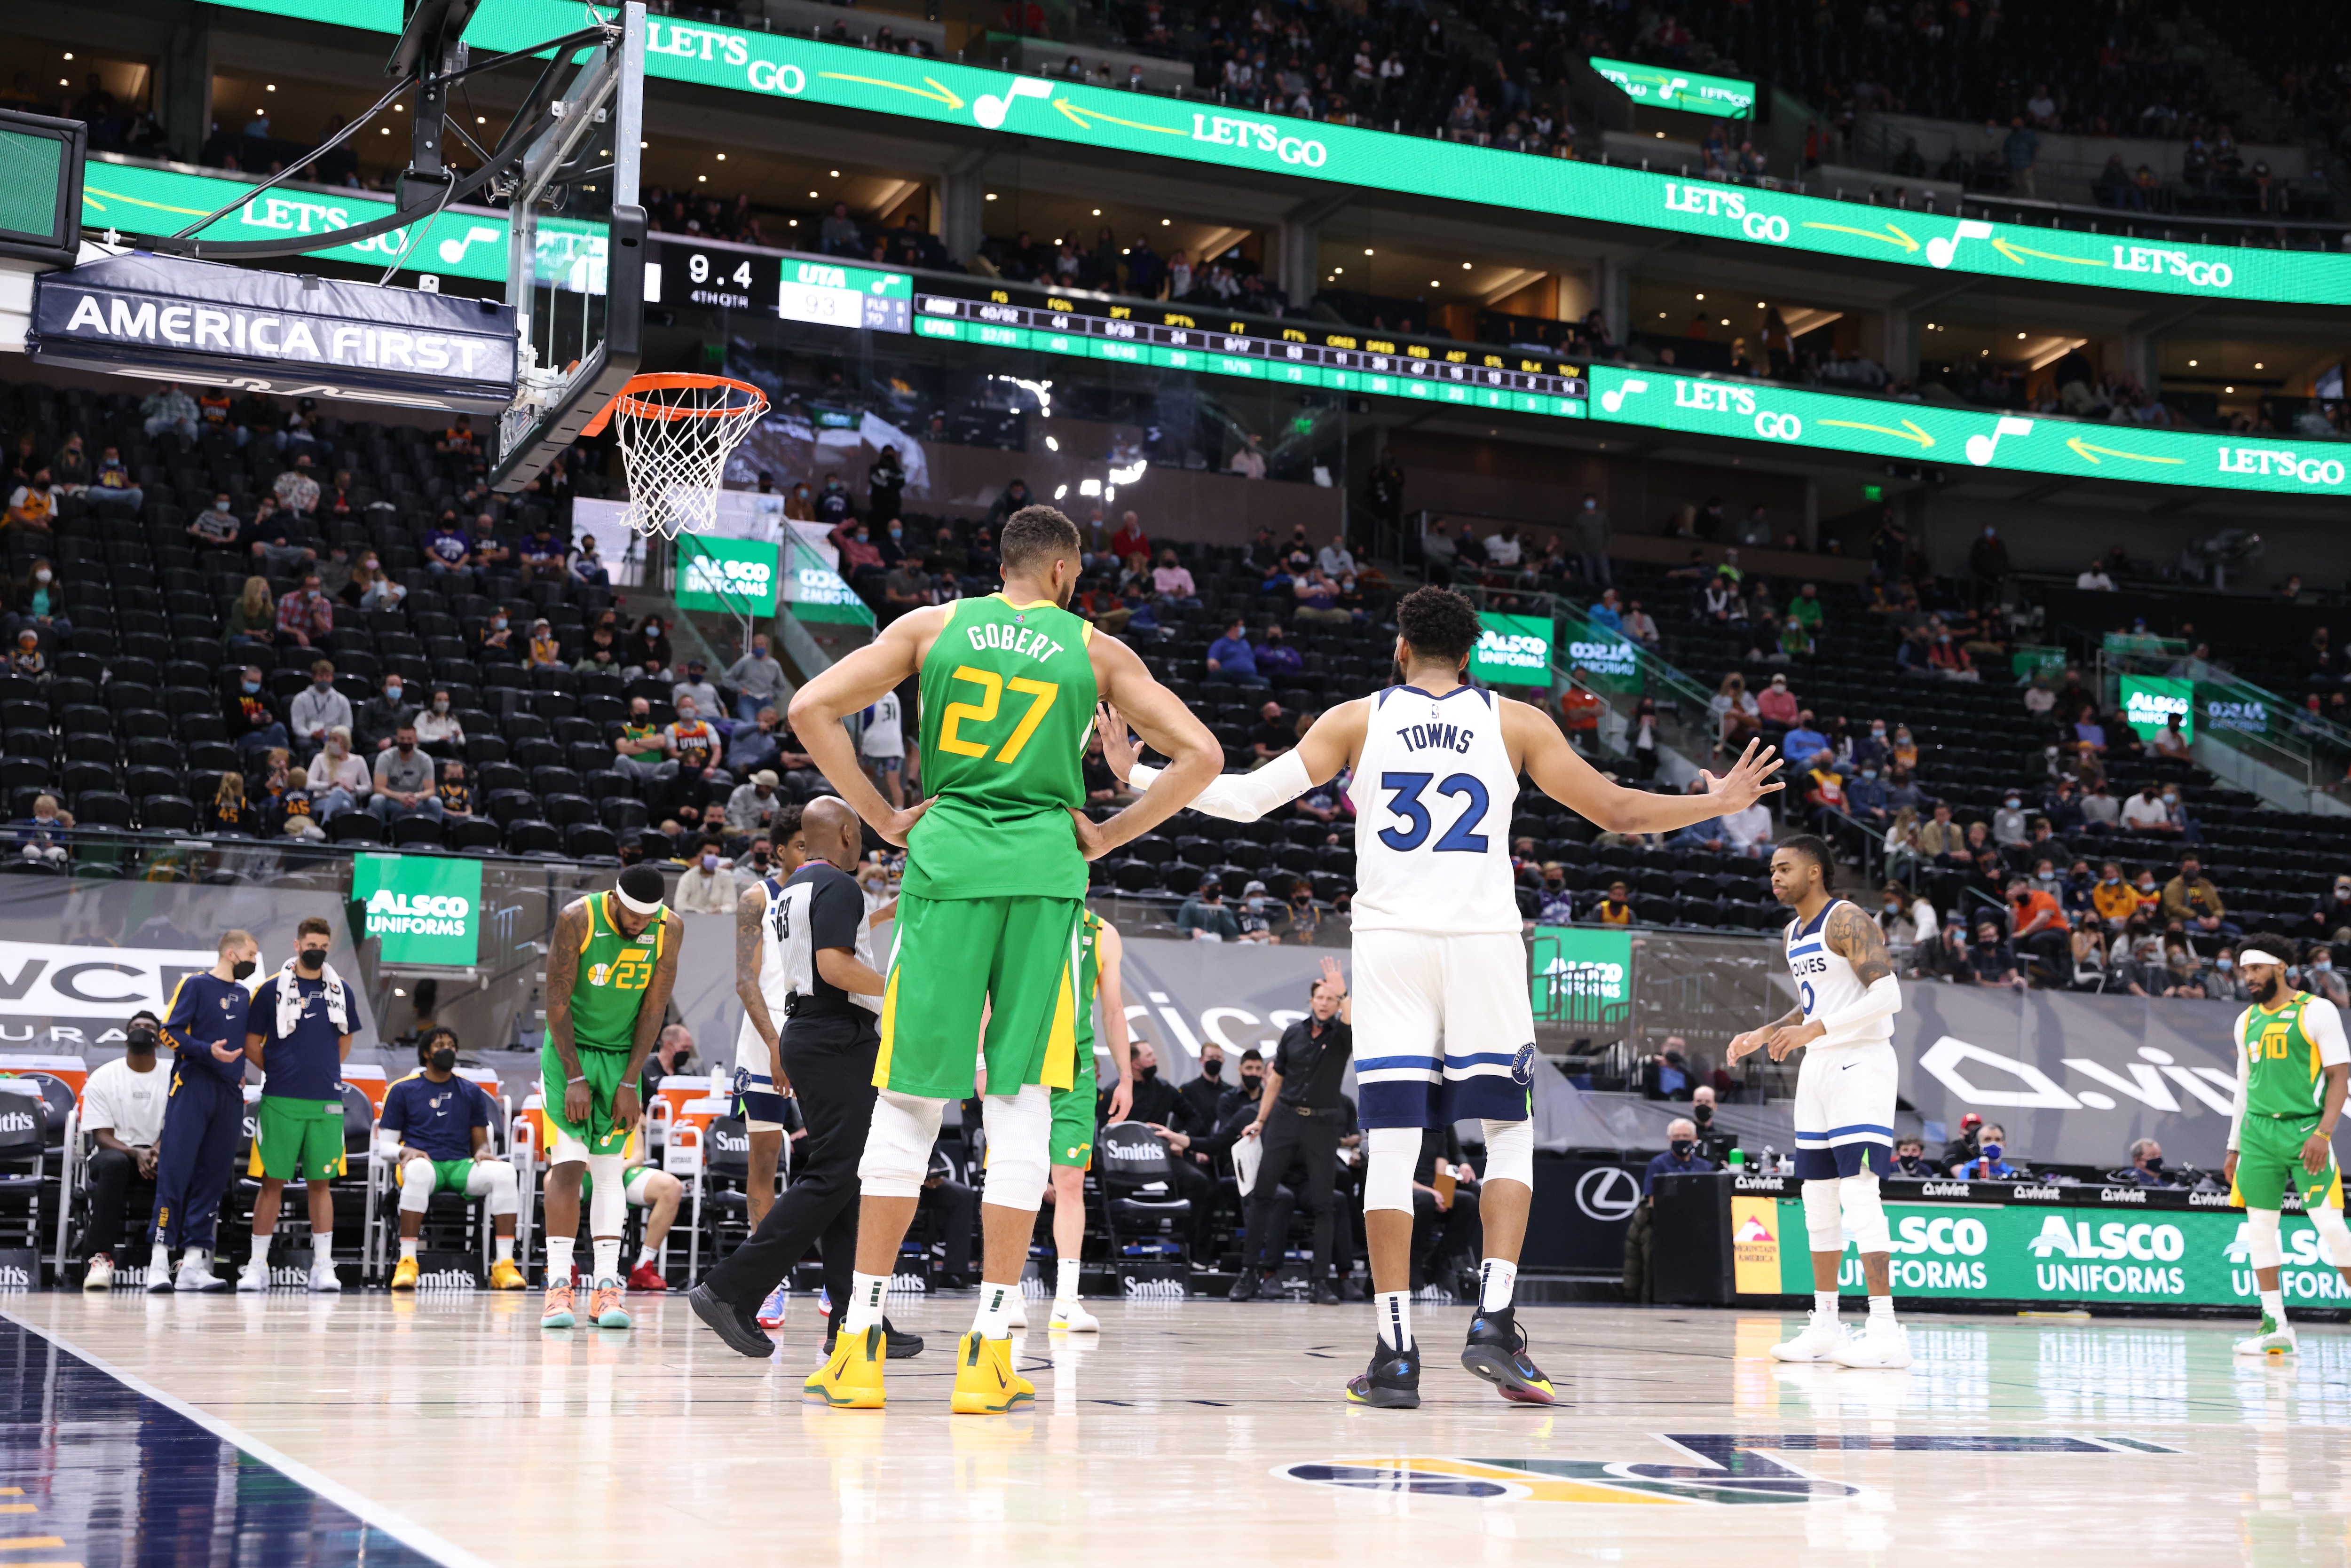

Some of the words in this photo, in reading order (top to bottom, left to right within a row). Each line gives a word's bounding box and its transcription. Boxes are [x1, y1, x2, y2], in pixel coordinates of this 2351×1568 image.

[646, 23, 748, 65] LET'S
[748, 61, 805, 95] GO
[1192, 114, 1278, 151] LET'S
[1277, 136, 1327, 167] GO
[241, 197, 348, 236] LET'S
[1665, 183, 1746, 220] LET'S
[1743, 212, 1790, 243] GO
[798, 264, 846, 288] UTA
[2113, 245, 2189, 276] LET'S
[2187, 261, 2233, 288] GO
[67, 295, 321, 357] AMERICA
[333, 326, 486, 373] FIRST
[1674, 380, 1756, 416] LET'S
[1754, 410, 1802, 441] GO
[2217, 447, 2297, 477] LET'S
[2296, 459, 2346, 485] GO
[966, 622, 1065, 663] GOBERT
[938, 665, 1059, 764] 27
[1396, 723, 1474, 754] TOWNS
[218, 807, 239, 823] 45
[286, 800, 311, 815] 45
[1377, 772, 1490, 853] 32
[366, 889, 469, 919] ALSCO
[776, 896, 792, 942] 63
[366, 915, 465, 937] UNIFORMS
[615, 962, 652, 990] 23
[2264, 1033, 2288, 1059] 10
[1106, 1139, 1165, 1161] Smith's
[2027, 1215, 2185, 1262] ALSCO
[1124, 1276, 1185, 1297] Smith's
[2036, 1263, 2185, 1295] UNIFORMS
